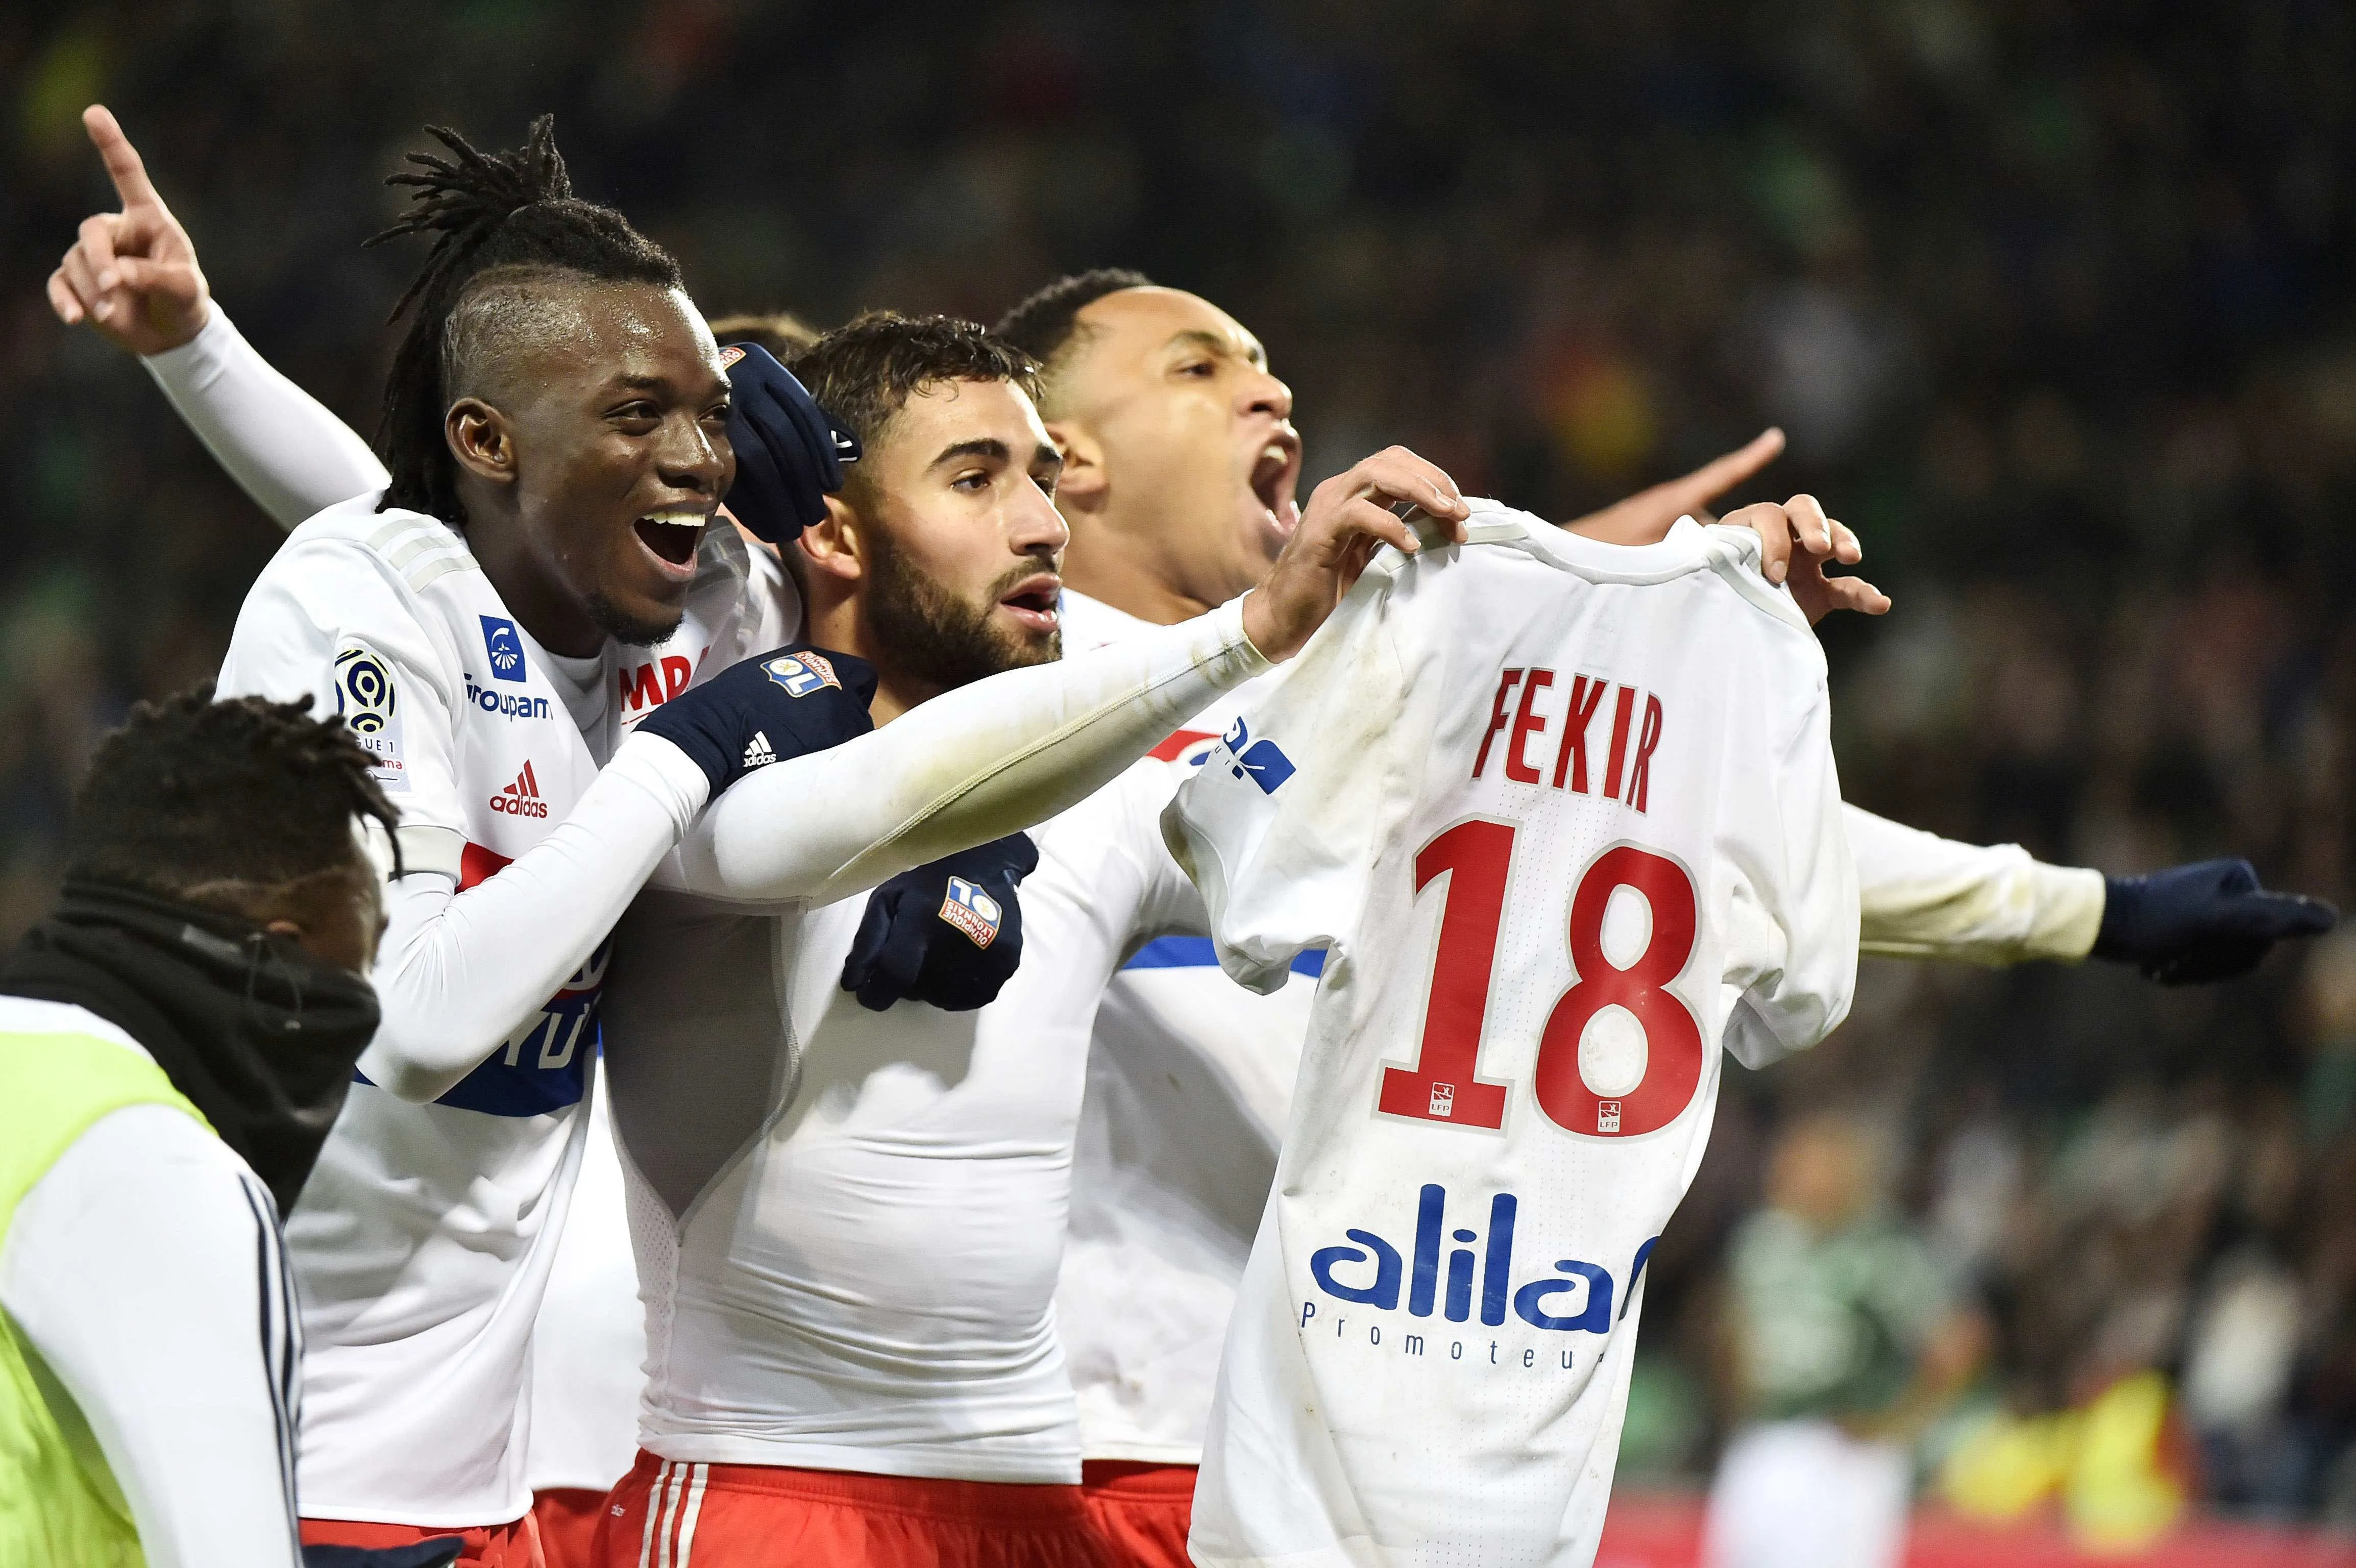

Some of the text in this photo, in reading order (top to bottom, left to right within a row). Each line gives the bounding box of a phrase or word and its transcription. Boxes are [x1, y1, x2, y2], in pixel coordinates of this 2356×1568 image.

[619, 645, 710, 711] MD
[1470, 667, 1663, 816] FEKIR
[489, 794, 548, 819] adidas
[943, 909, 988, 945] OLYMPIQUE
[947, 901, 994, 939] LYONNAIS
[1371, 812, 1708, 1144] 18
